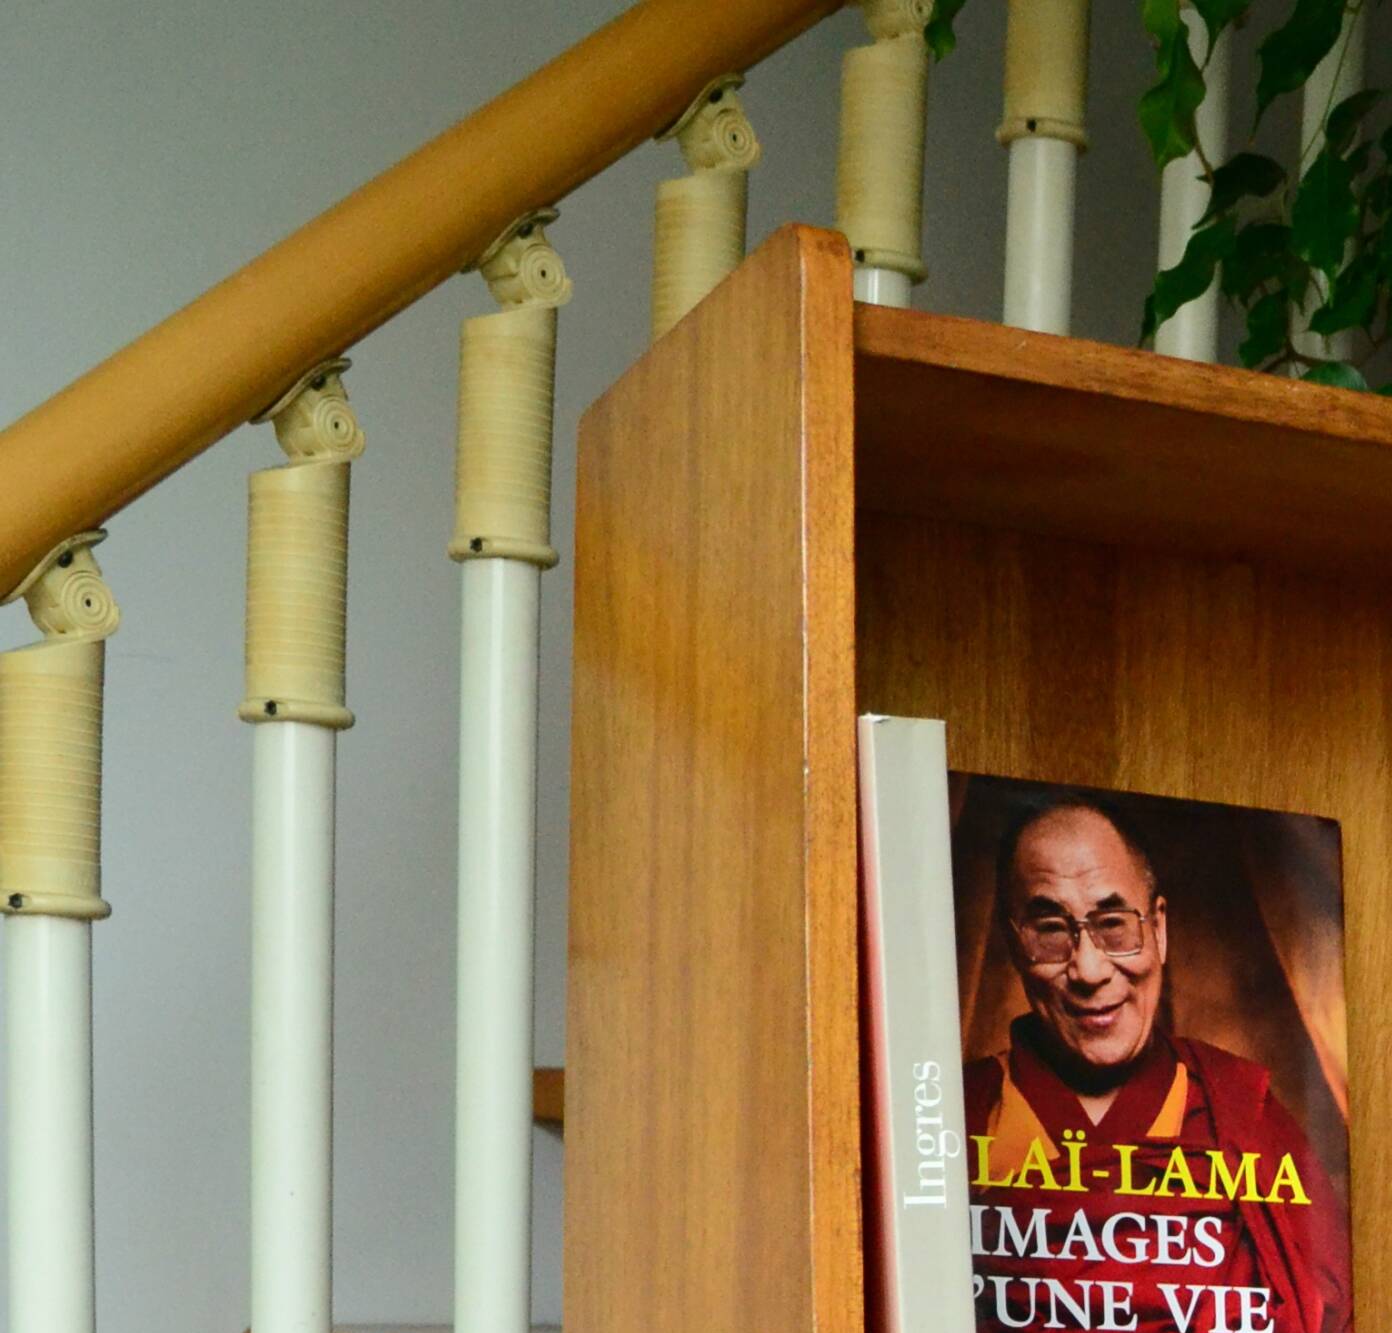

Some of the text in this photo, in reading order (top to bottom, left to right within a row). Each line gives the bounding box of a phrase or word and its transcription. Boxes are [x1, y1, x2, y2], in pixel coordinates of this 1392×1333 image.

[904, 1060, 961, 1210] Ingres
[969, 1129, 1312, 1205] LAÏ-LAMA
[970, 1204, 1226, 1267] IMAGES
[973, 1274, 1138, 1332] 'UNE
